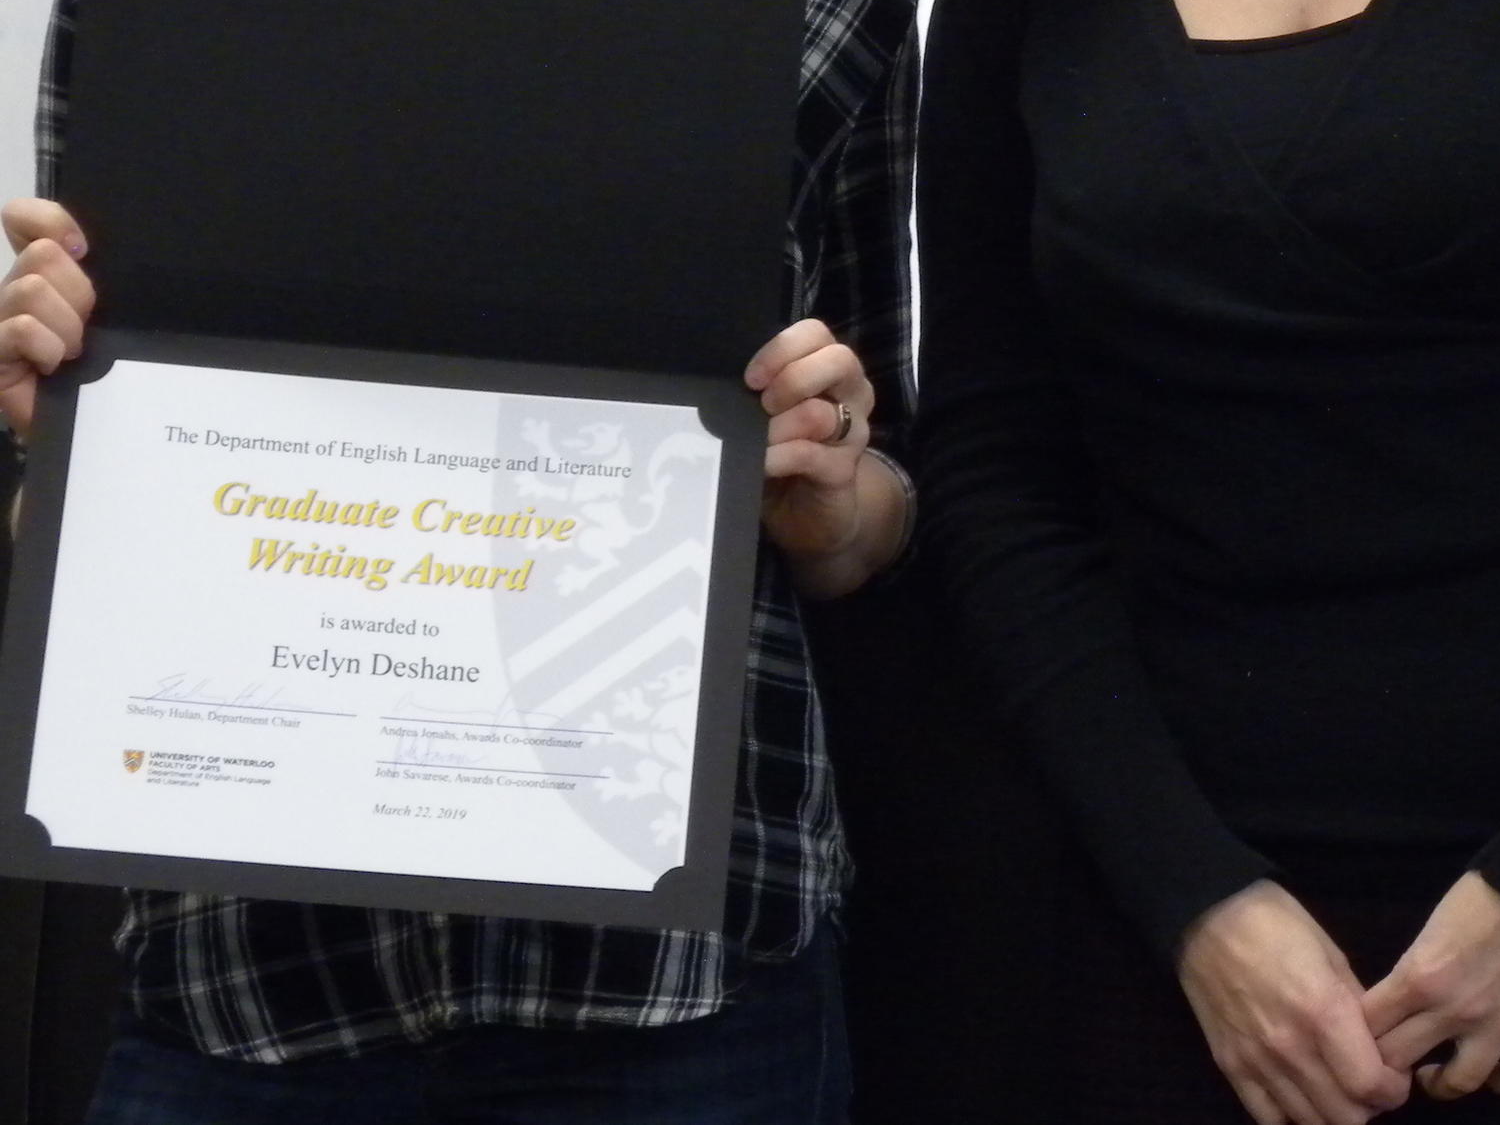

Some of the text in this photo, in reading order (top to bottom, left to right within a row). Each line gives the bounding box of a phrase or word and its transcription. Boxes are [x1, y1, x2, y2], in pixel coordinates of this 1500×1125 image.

[163, 425, 632, 479] The Department of English Language and Literature
[211, 481, 577, 543] Graduate Creative
[246, 537, 535, 593] Writing Award
[319, 612, 440, 638] is awarded to
[270, 644, 481, 683] Evelyn Deshane
[125, 704, 165, 719] Shelley
[206, 711, 268, 727] Department
[271, 716, 301, 728] Chair
[379, 725, 419, 737] Andrea
[462, 731, 500, 743] Awards
[503, 734, 582, 749] Co-coordinator
[148, 760, 184, 769] FACULTY
[200, 764, 221, 772] ARTS
[149, 751, 275, 768] UNIVERSITY OF WATERLOO
[146, 776, 160, 784] and
[204, 772, 232, 782] English
[234, 775, 271, 785] Language
[375, 767, 400, 779] John
[454, 773, 494, 785] Awards
[496, 776, 576, 791] Co-coordinator
[372, 802, 411, 817] March
[436, 807, 467, 821] 2019
